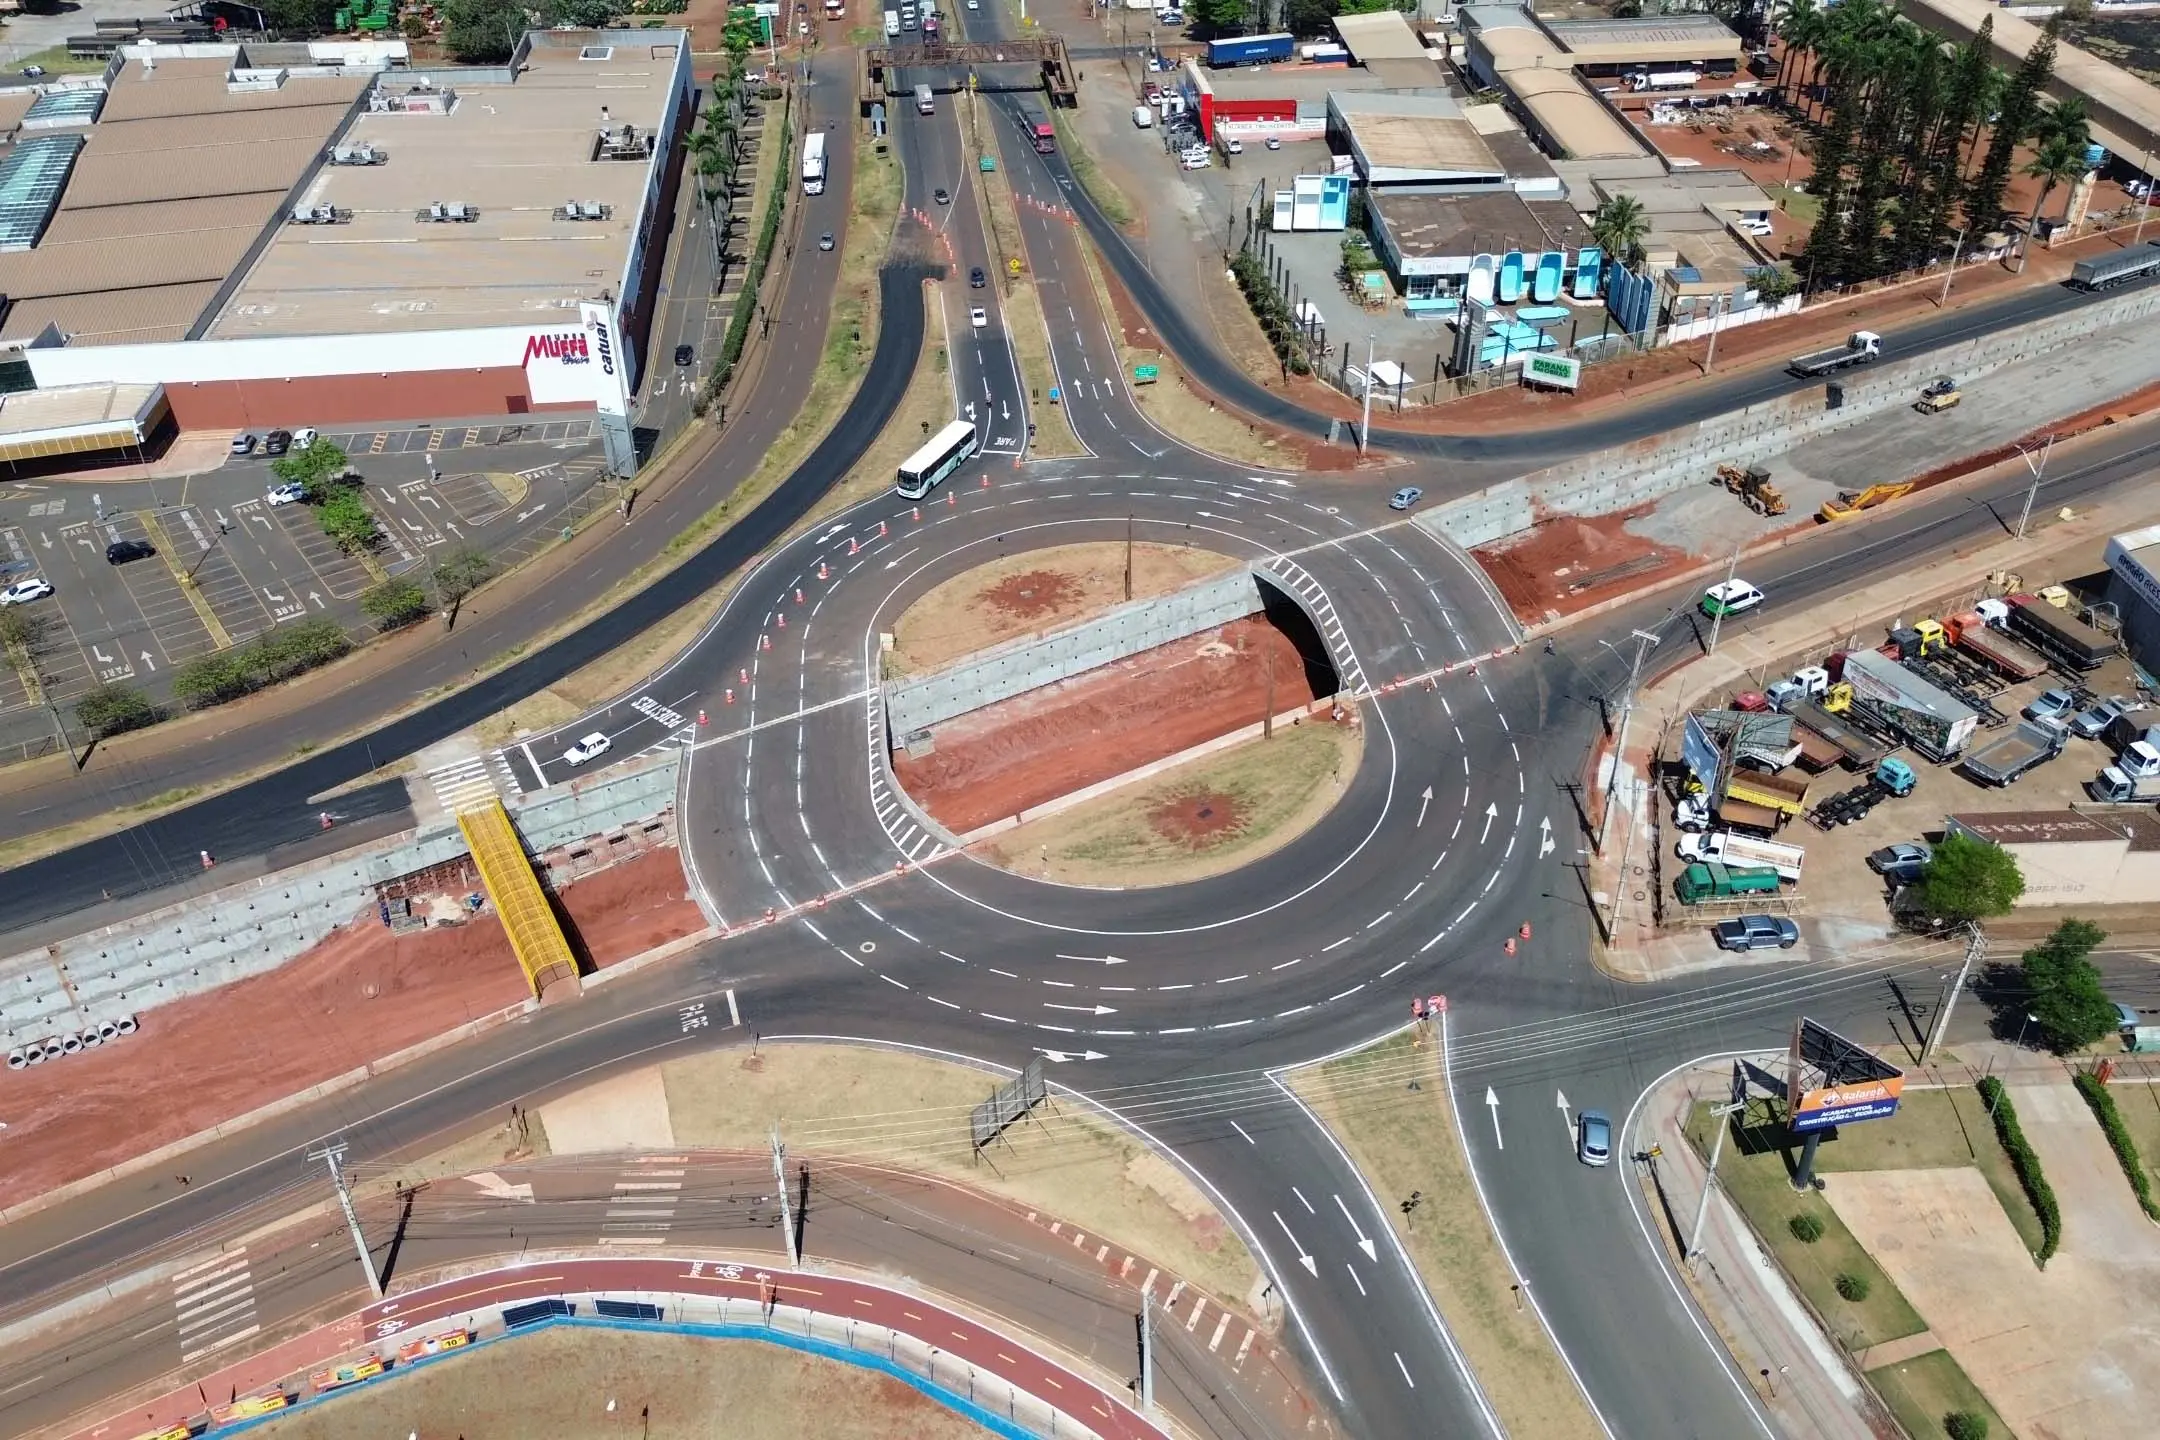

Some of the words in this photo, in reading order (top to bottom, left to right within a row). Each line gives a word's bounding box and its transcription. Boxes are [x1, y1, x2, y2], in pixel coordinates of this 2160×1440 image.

[523, 468, 555, 481] PARE
[402, 483, 428, 496] PARE
[235, 502, 262, 515] PARE
[62, 526, 90, 538] PARE
[273, 603, 303, 617] PARE
[102, 663, 132, 678] PARE
[631, 696, 687, 728] PEDESTRES
[679, 1002, 709, 1033] PARE
[689, 1262, 704, 1278] PARE
[445, 1339, 458, 1347] 10
